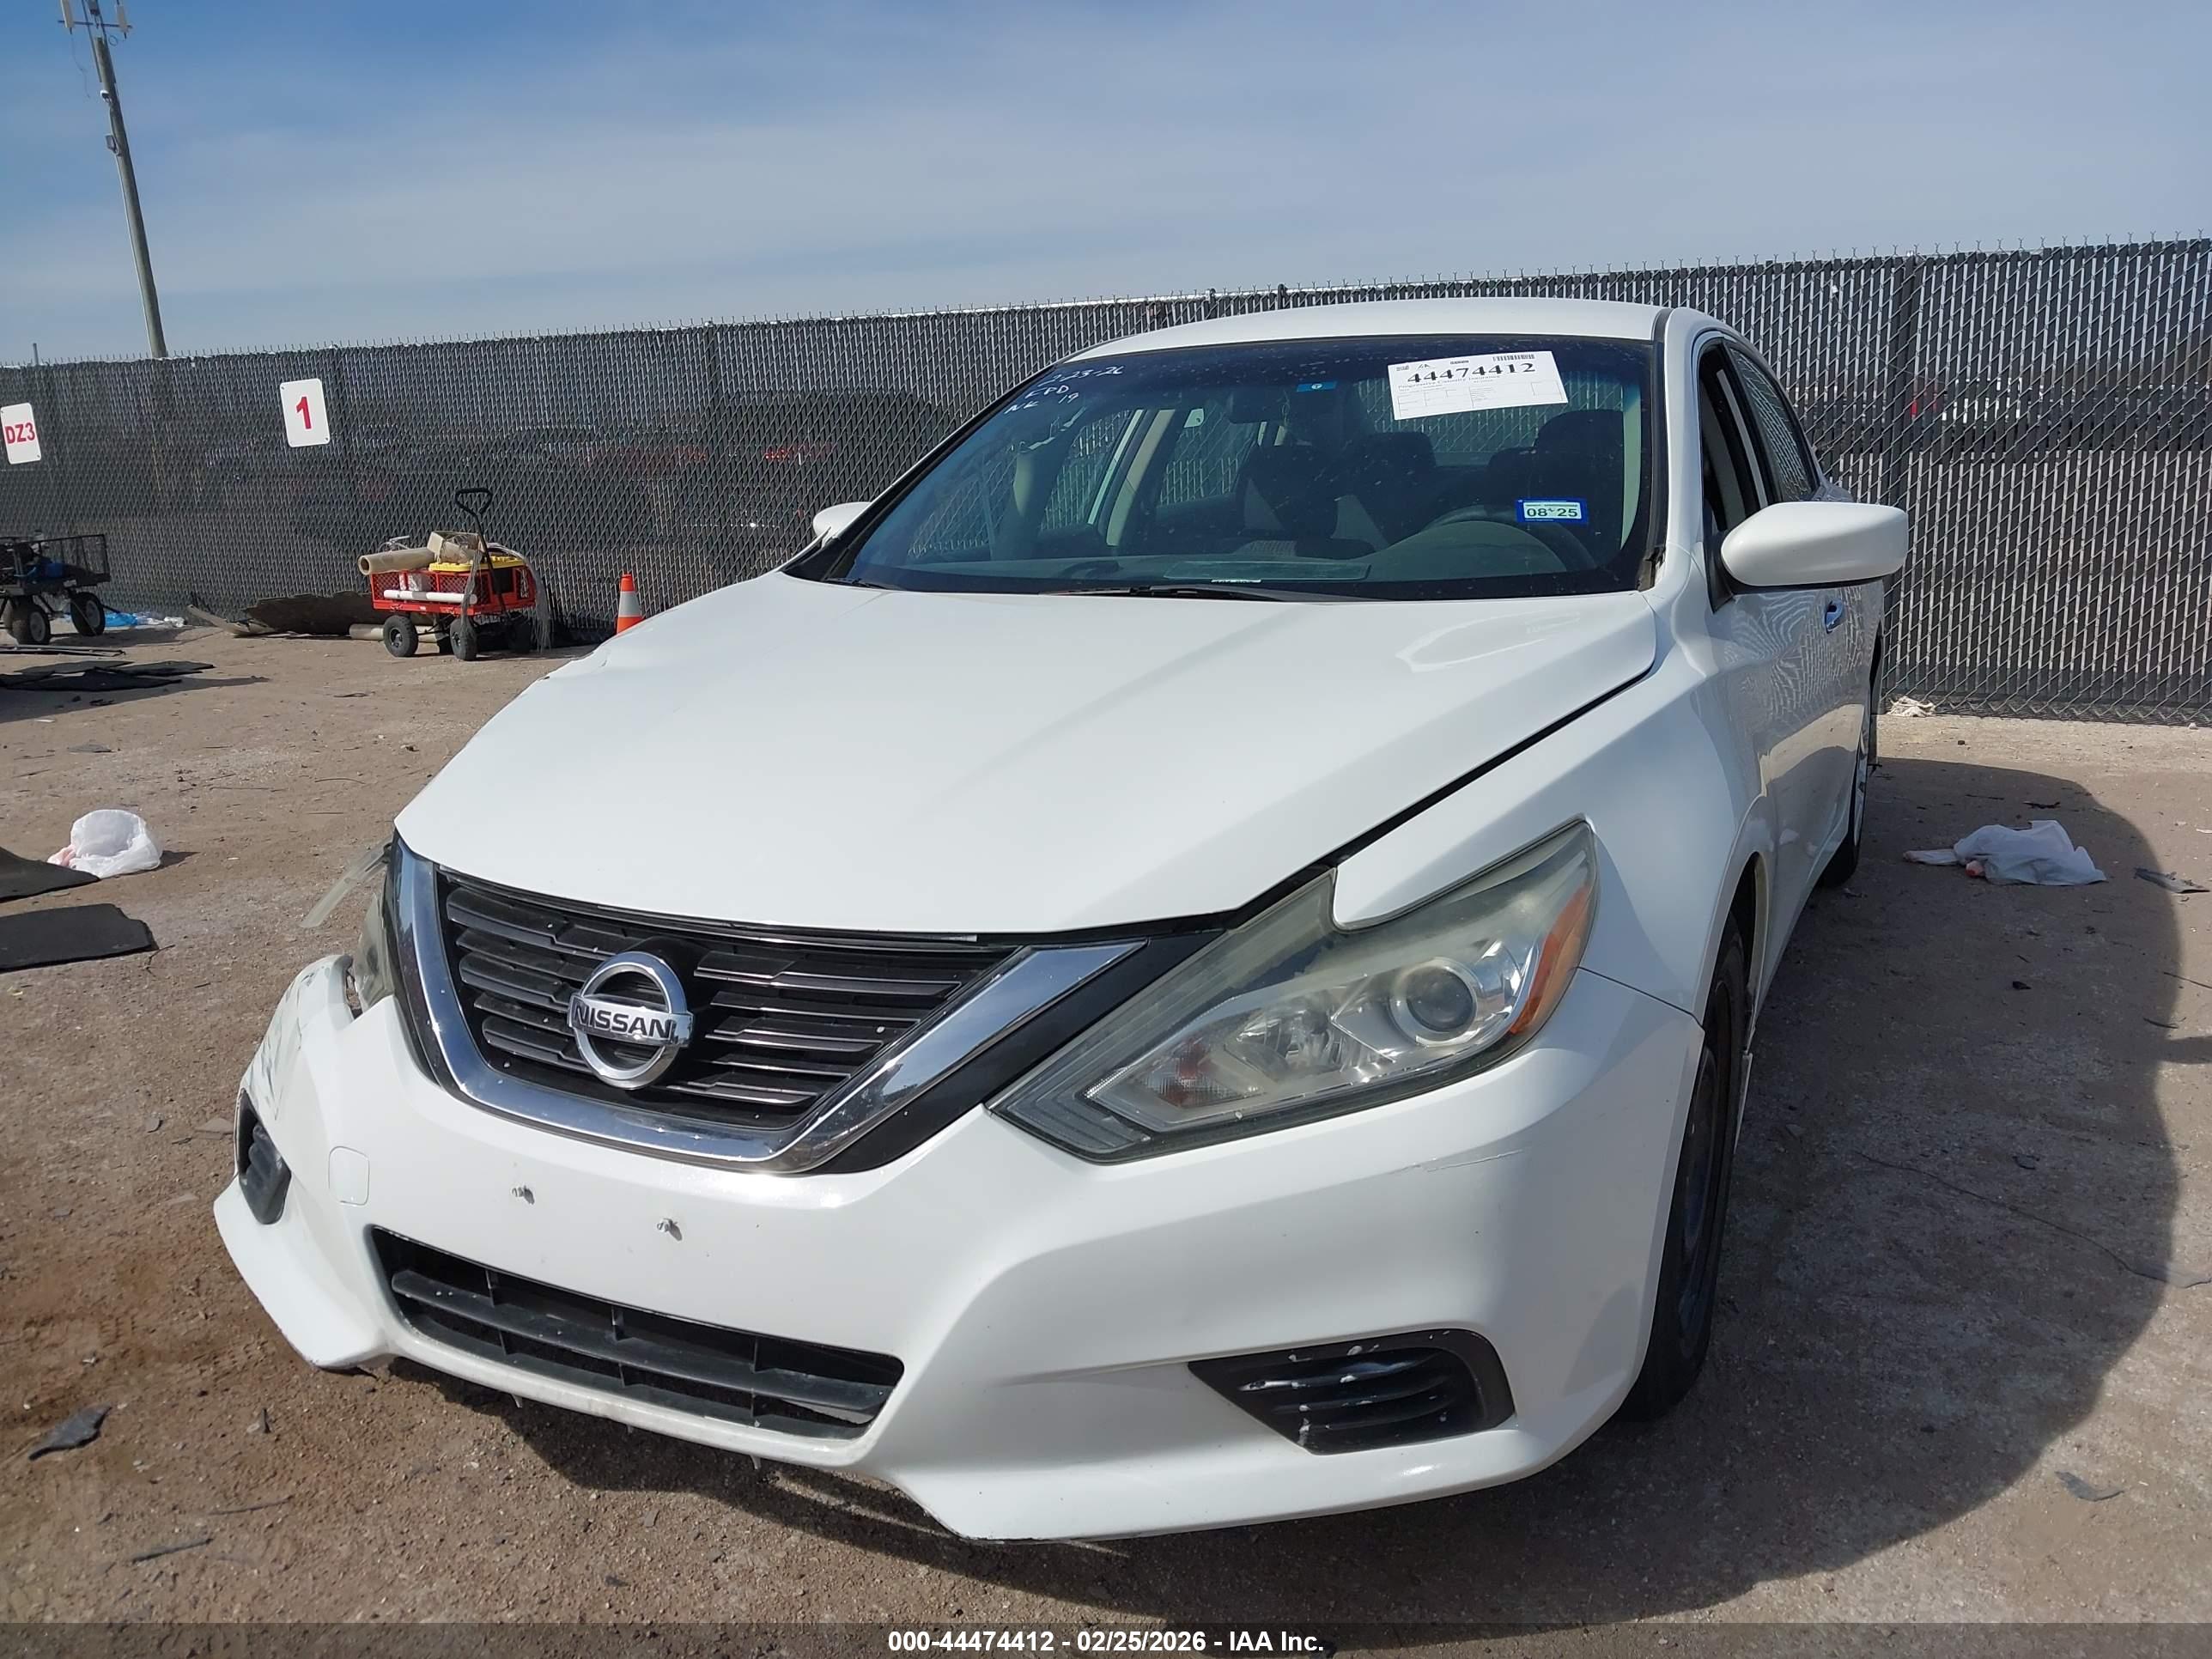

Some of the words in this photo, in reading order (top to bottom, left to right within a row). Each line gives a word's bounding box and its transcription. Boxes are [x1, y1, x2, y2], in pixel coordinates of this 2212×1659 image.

[1407, 362, 1536, 384] 44474412
[295, 396, 313, 430] 1
[4, 422, 36, 445] DZ3
[1526, 508, 1547, 518] 08
[1557, 508, 1578, 518] 25
[573, 1004, 672, 1040] NISSAN
